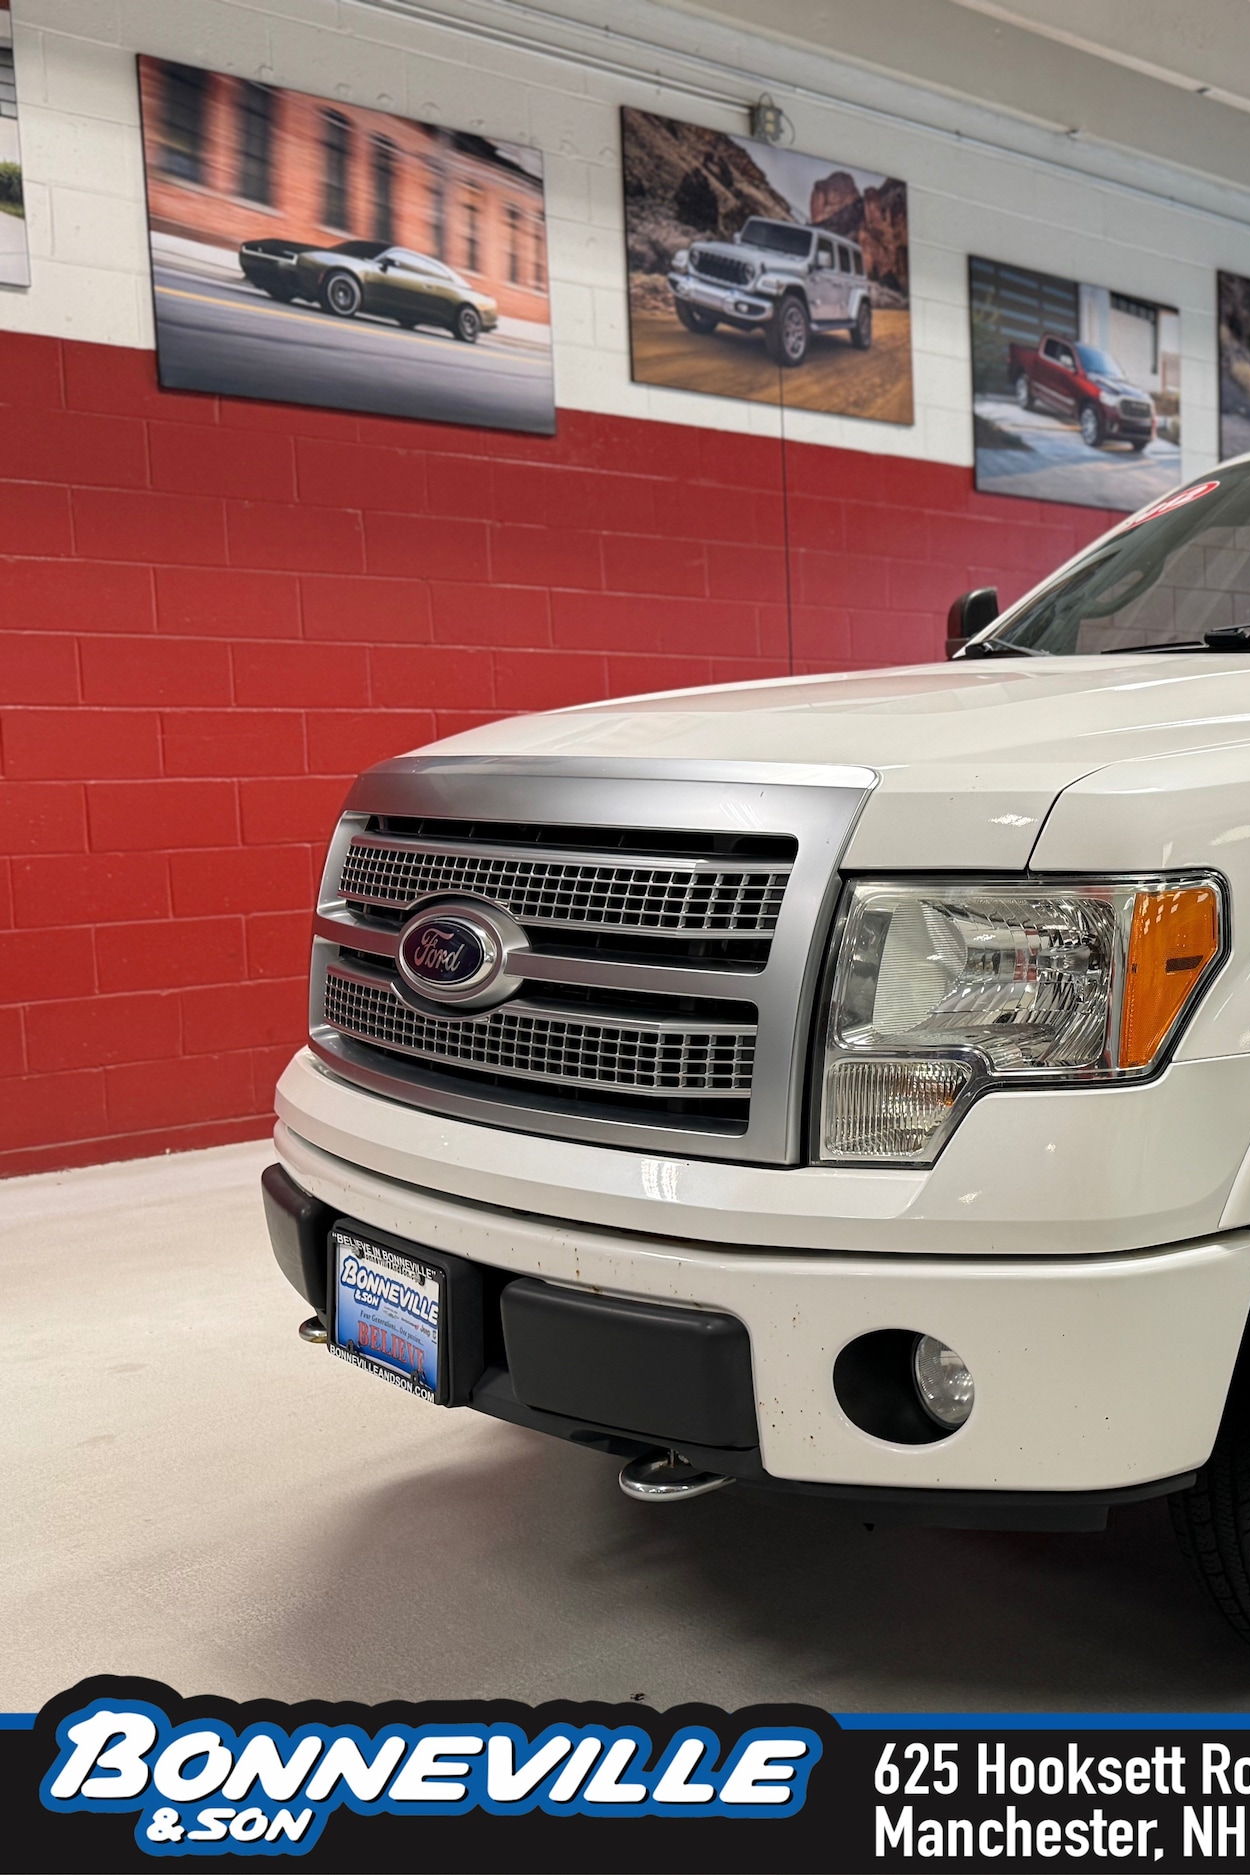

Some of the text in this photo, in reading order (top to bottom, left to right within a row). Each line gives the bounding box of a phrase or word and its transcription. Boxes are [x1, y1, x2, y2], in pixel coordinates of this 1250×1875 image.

[414, 927, 466, 972] Ford
[373, 1245, 382, 1259] IN
[342, 1261, 438, 1326] BONNEVILLE
[358, 1320, 425, 1373] BELIEVE
[329, 1344, 435, 1404] BONNEVILLEANDSON.COM
